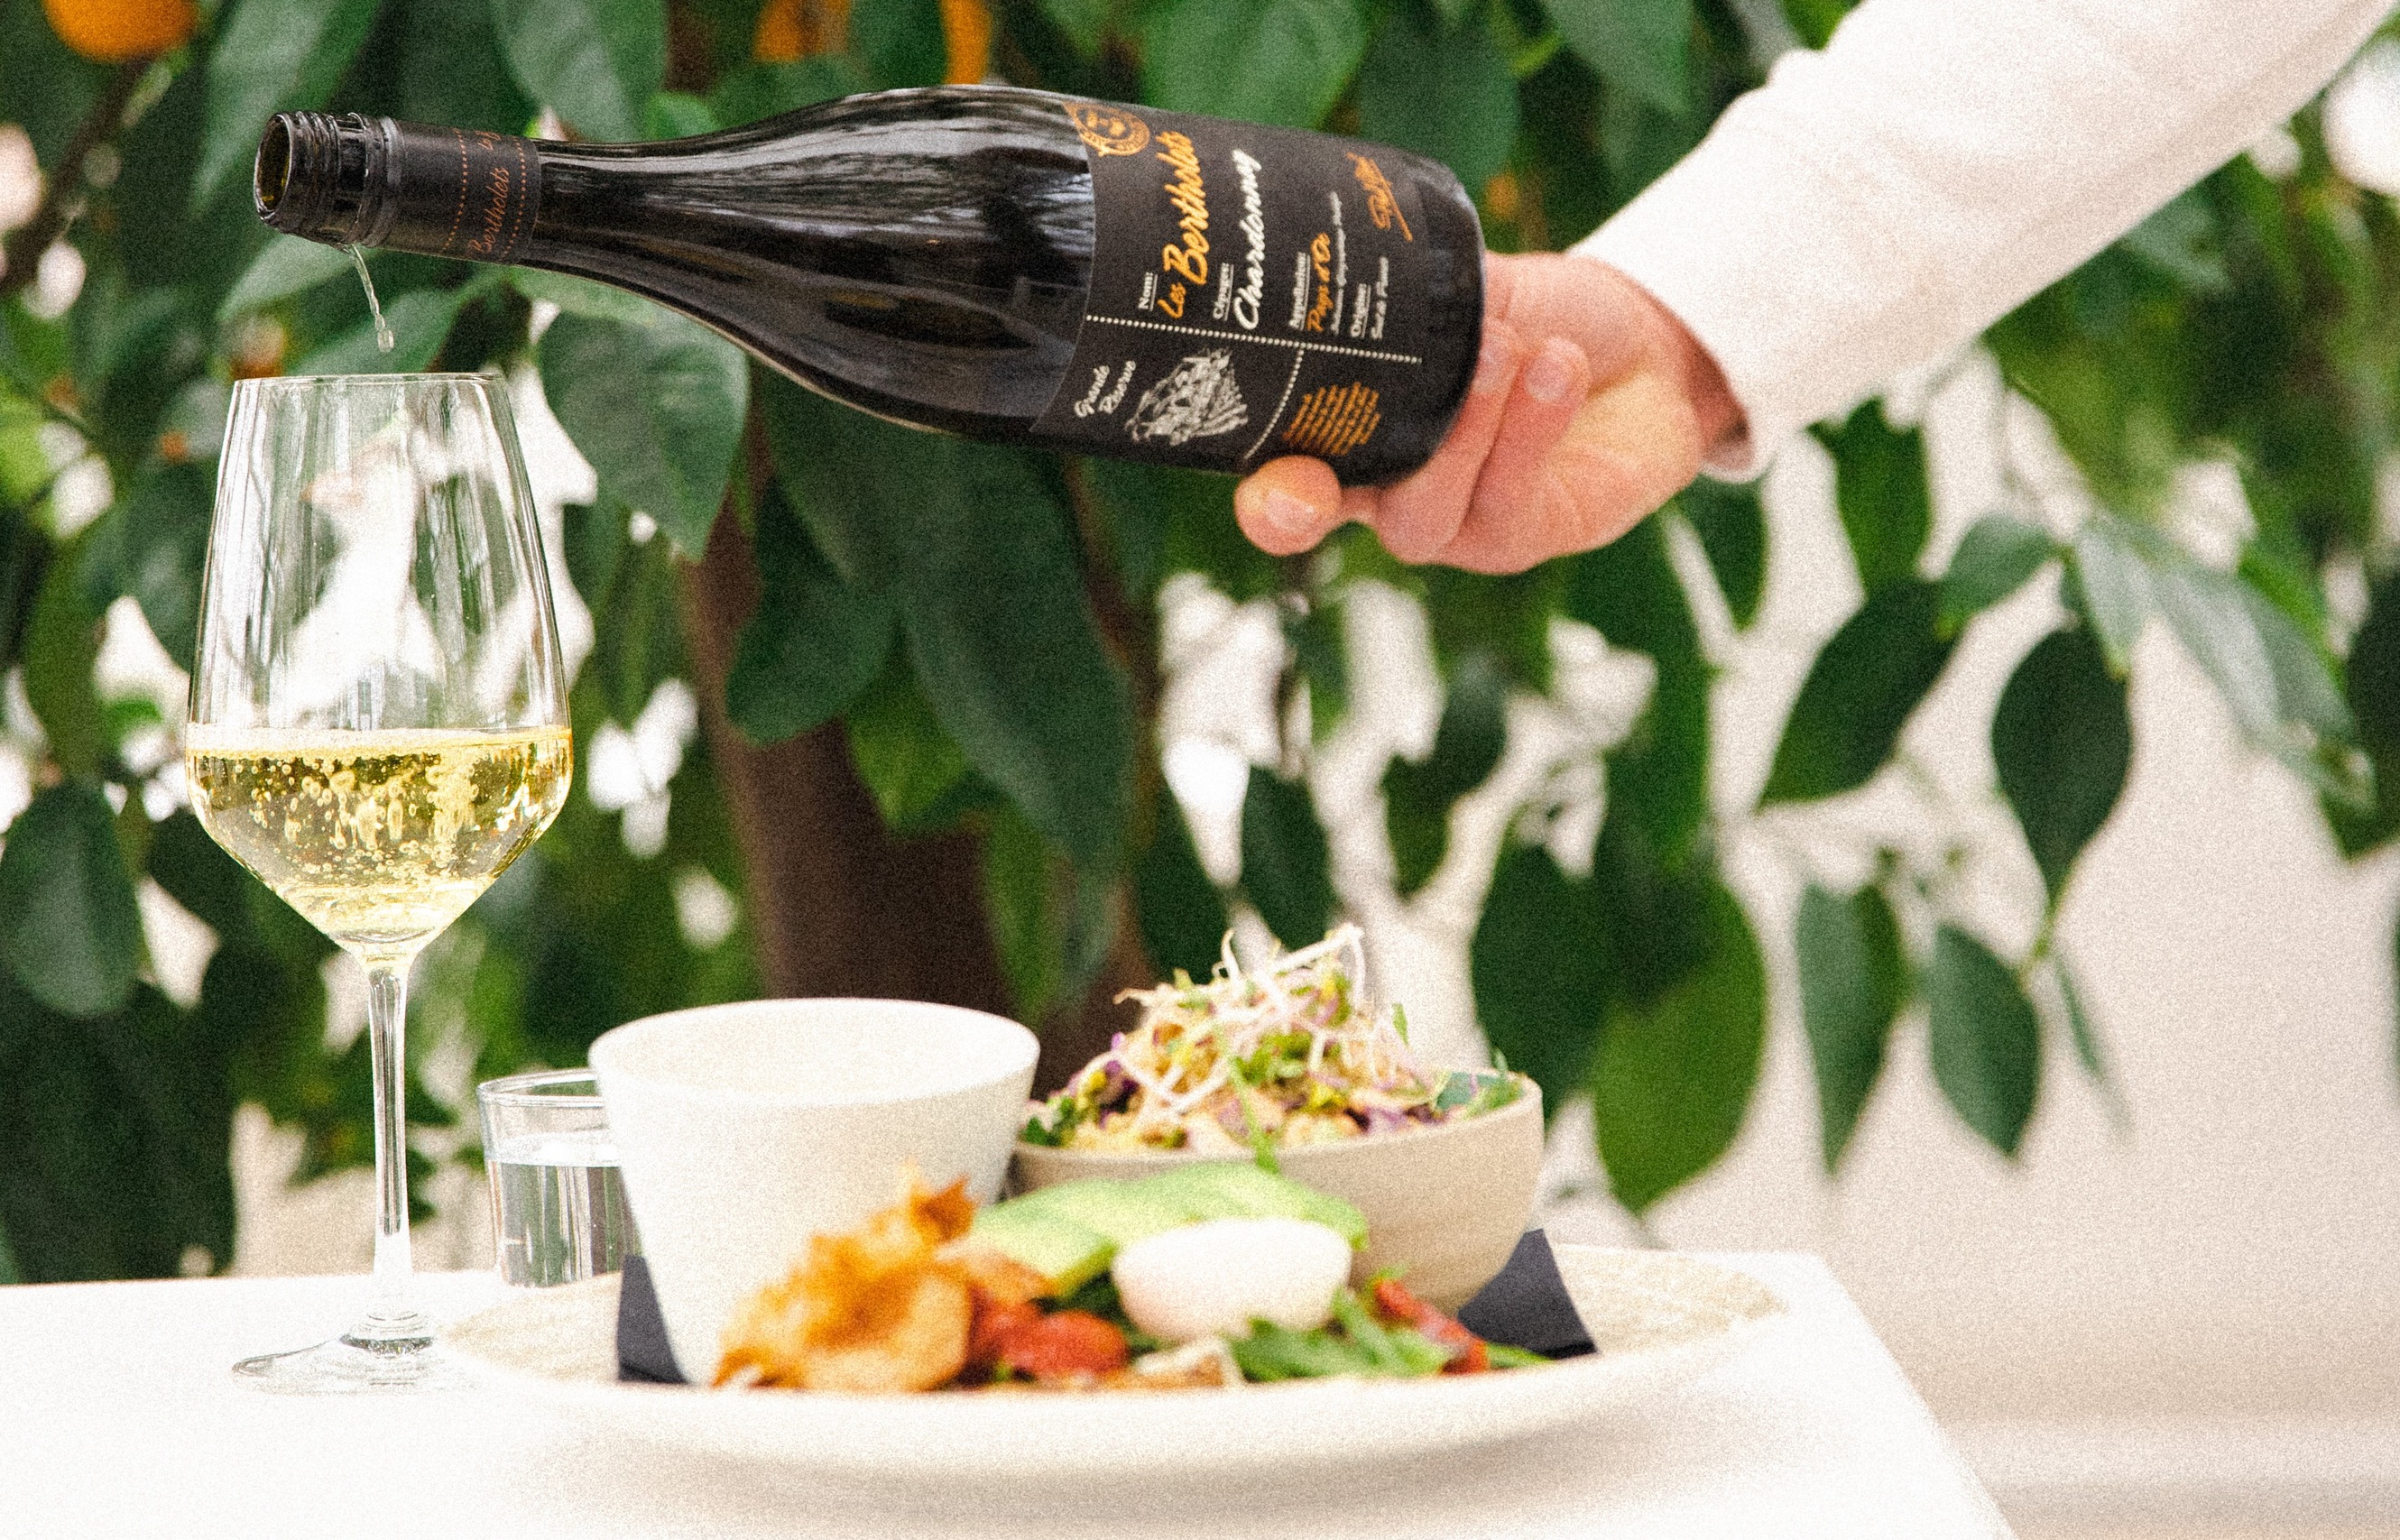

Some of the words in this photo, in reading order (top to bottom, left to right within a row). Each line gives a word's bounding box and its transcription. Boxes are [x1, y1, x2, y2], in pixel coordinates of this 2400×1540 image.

[467, 166, 510, 254] Bertholets
[1155, 131, 1210, 285] Bertholets
[1231, 149, 1265, 330] Chardonnay
[1138, 271, 1155, 310] Nom:
[1158, 282, 1186, 318] Les
[1074, 365, 1110, 418] Grande
